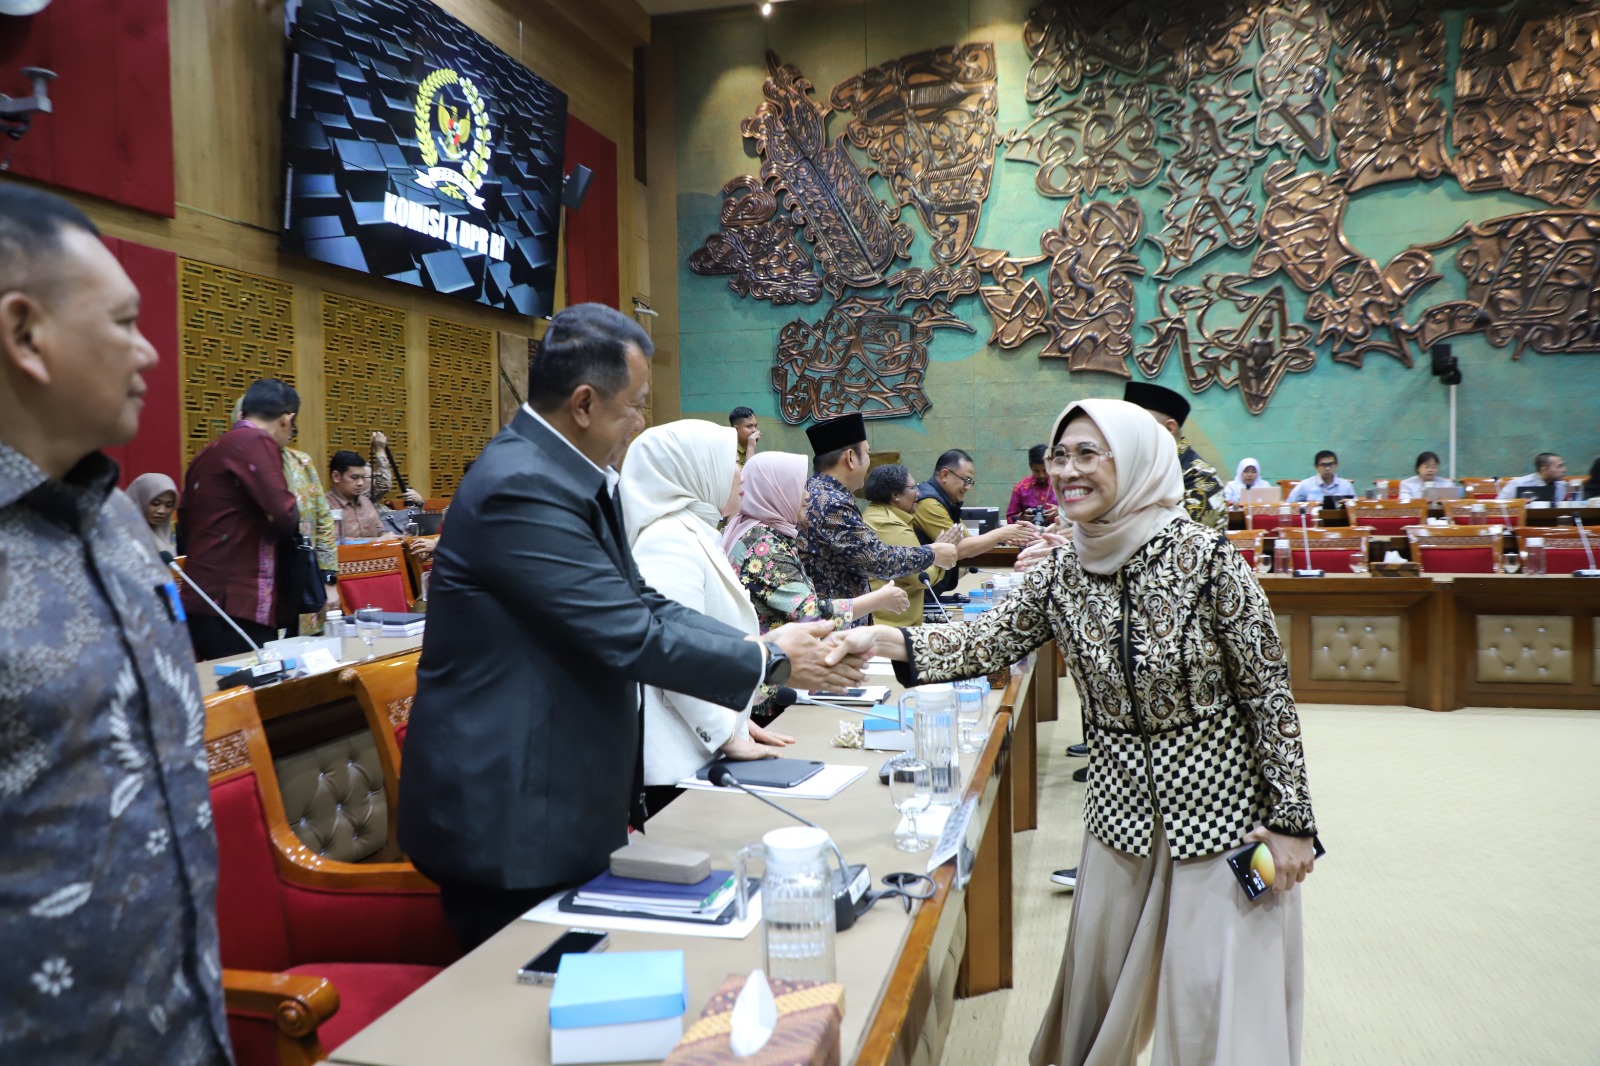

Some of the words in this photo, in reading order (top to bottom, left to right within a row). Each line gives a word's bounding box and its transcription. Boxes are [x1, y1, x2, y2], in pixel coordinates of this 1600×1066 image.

[383, 191, 445, 240] KOMISI
[446, 215, 458, 245] X
[459, 220, 489, 255] DPR
[489, 232, 505, 261] RI
